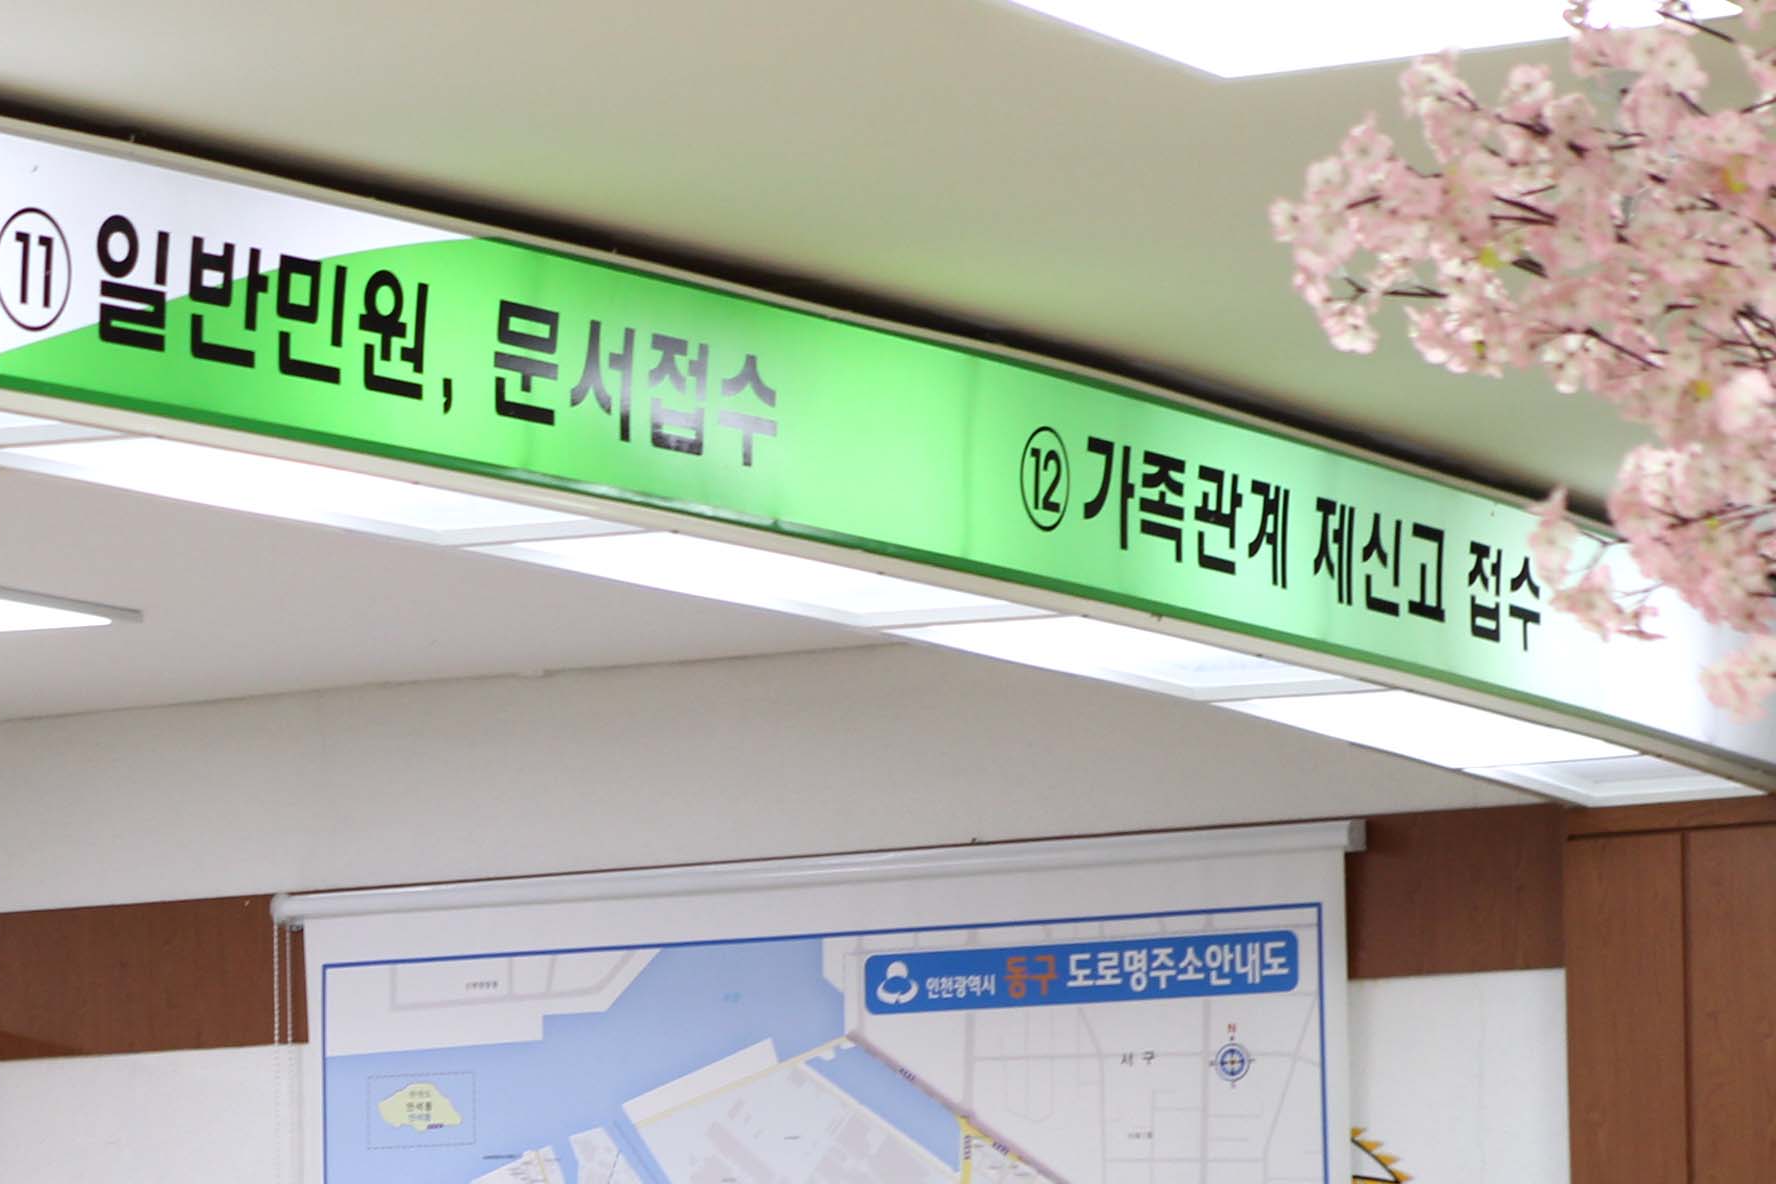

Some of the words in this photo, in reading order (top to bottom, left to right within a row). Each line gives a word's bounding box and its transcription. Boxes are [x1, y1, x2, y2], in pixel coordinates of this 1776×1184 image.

[96, 213, 454, 415] 일반민원,
[493, 299, 779, 467] 문서접수
[1084, 436, 1290, 590] 가족관계
[1313, 496, 1446, 623] 제신고
[1467, 539, 1543, 652] 접수
[926, 974, 996, 999] 인천광역시
[1004, 954, 1059, 999] 동구
[1067, 941, 1289, 993] 도로명주소안내도
